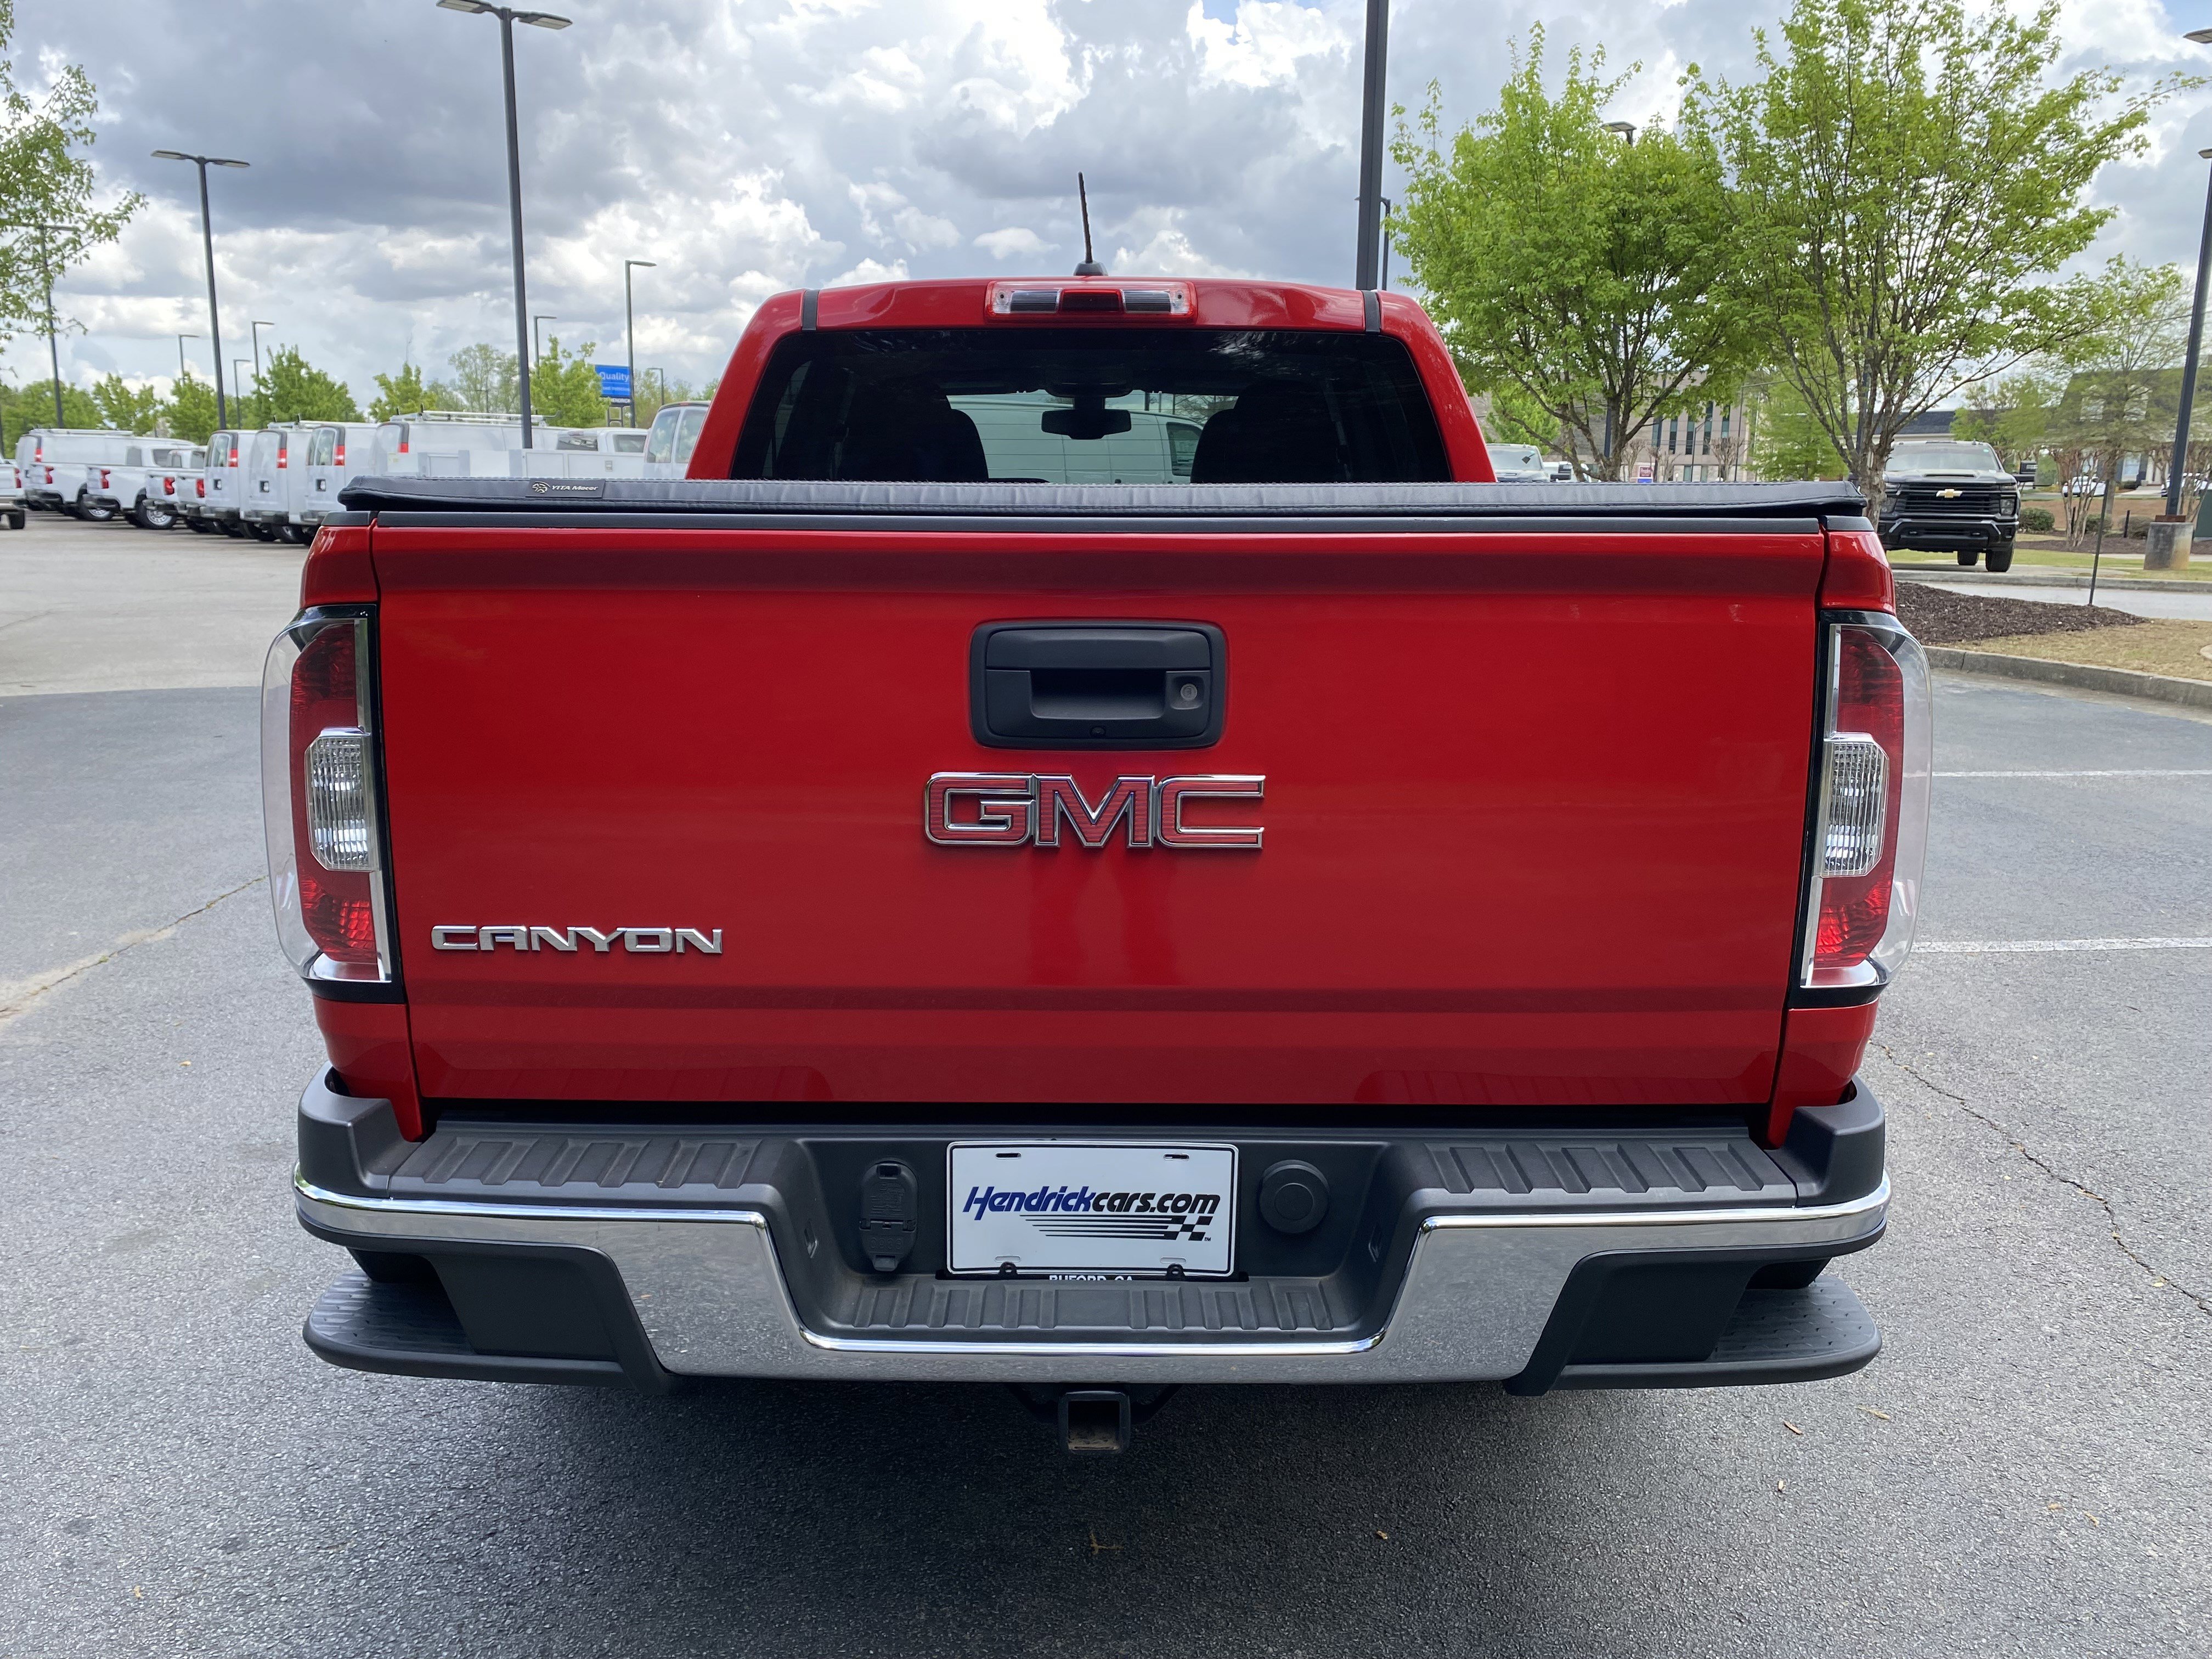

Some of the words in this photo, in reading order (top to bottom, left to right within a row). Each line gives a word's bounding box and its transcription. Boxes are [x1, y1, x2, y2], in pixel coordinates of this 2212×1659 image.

[599, 372, 629, 382] Quality
[924, 772, 1265, 849] GMC
[431, 926, 723, 953] CANYON
[962, 1186, 1221, 1221] Hendrickcars.com
